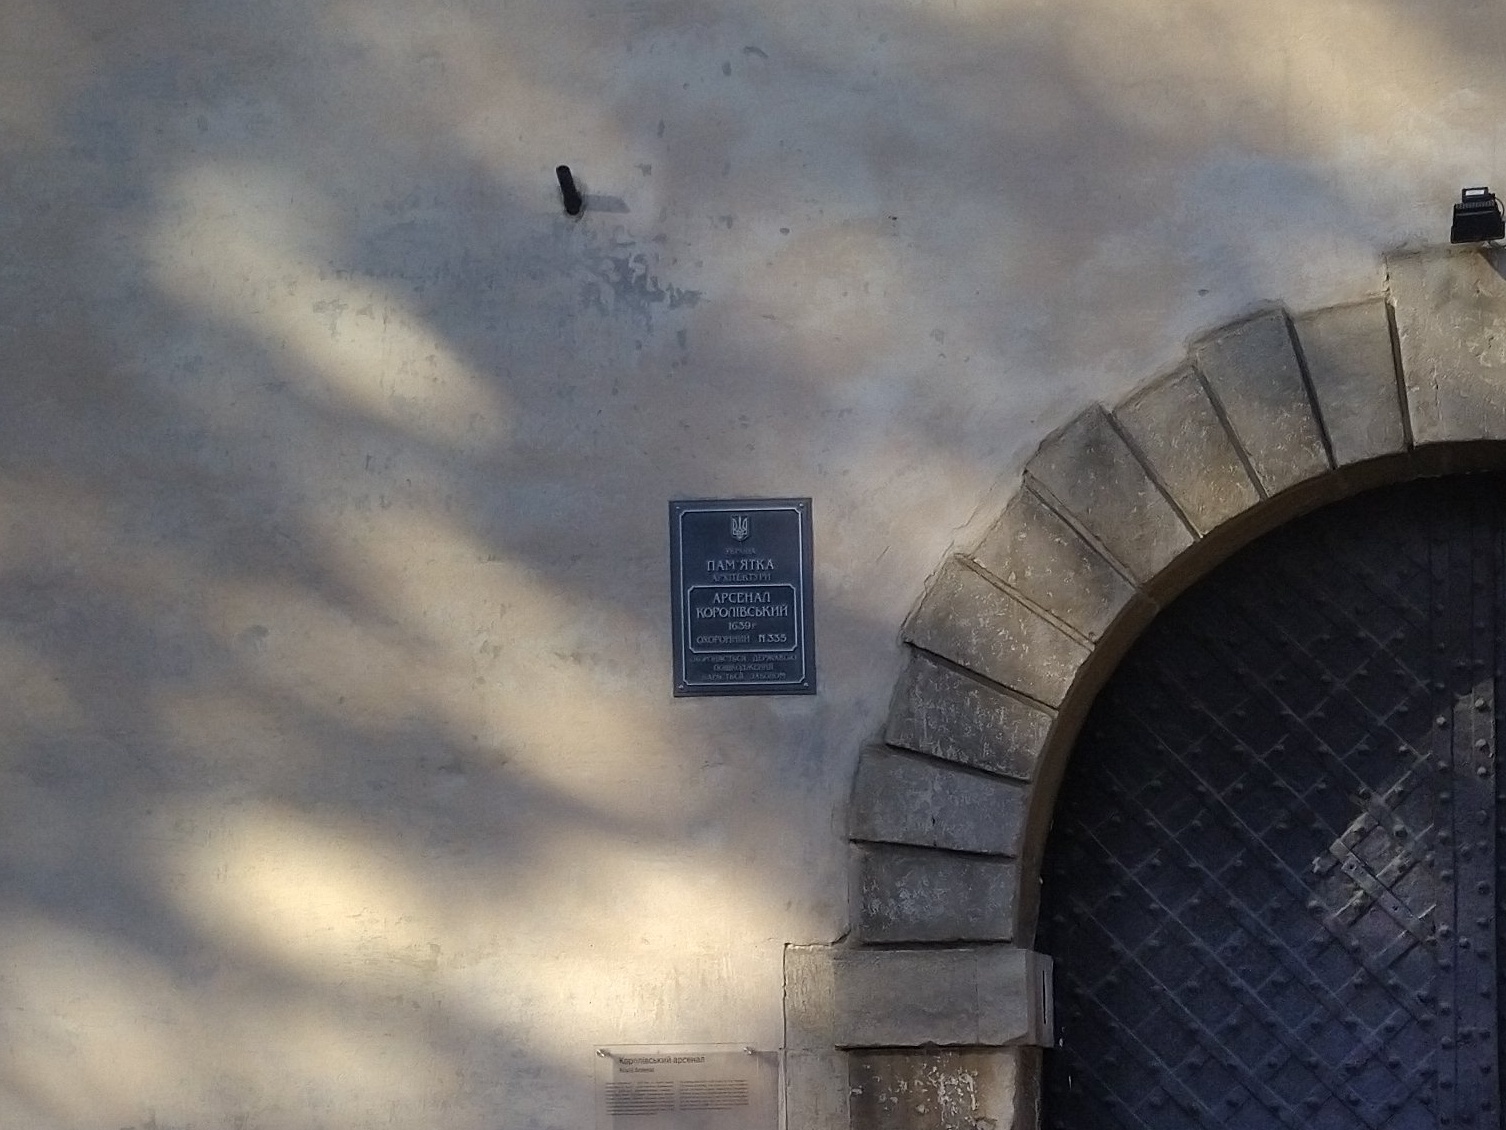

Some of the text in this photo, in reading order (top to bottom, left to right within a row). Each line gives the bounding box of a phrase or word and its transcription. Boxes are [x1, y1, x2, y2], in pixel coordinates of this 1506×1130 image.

[713, 591, 771, 604] АРСЕНАЛ
[696, 604, 788, 619] КОРОЛІВСЬКИЙ
[619, 1056, 705, 1065] Королівський арсенал
